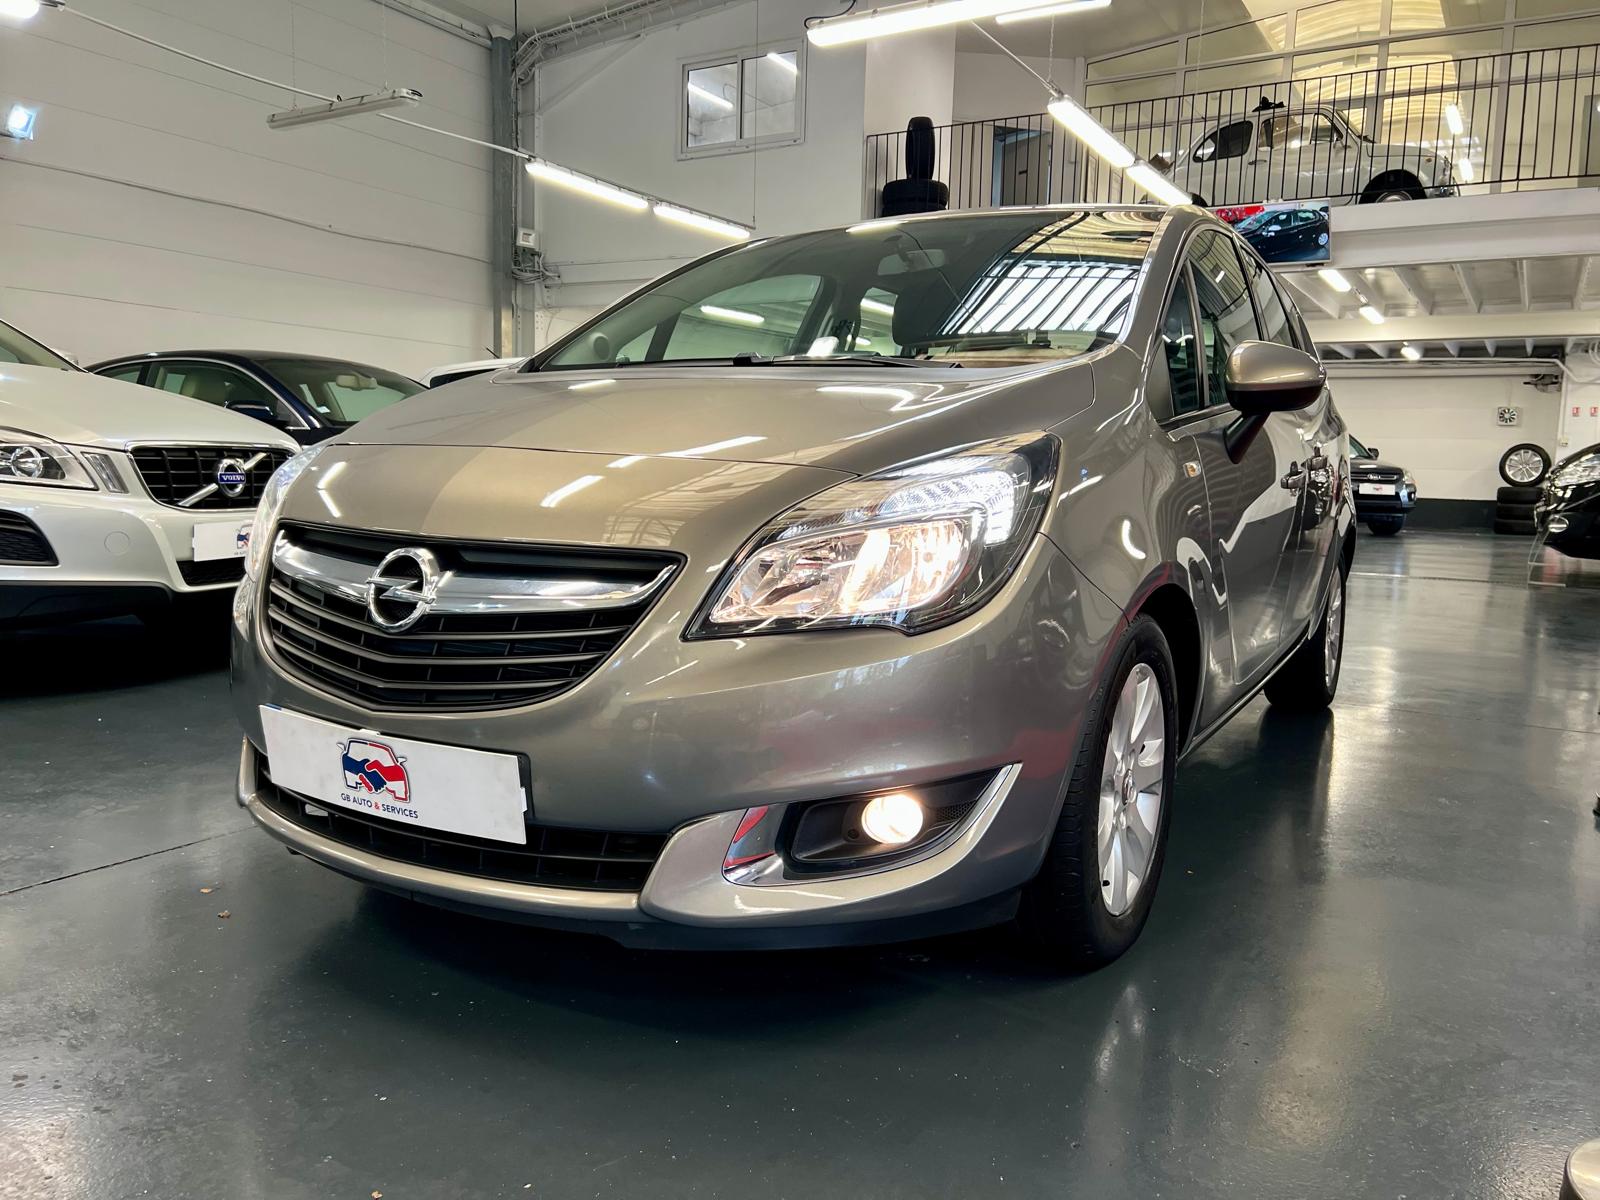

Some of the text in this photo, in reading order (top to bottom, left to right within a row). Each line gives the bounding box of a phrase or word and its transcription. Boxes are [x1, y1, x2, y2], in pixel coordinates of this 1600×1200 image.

[341, 793, 418, 818] GB AUTO & SERVICES
